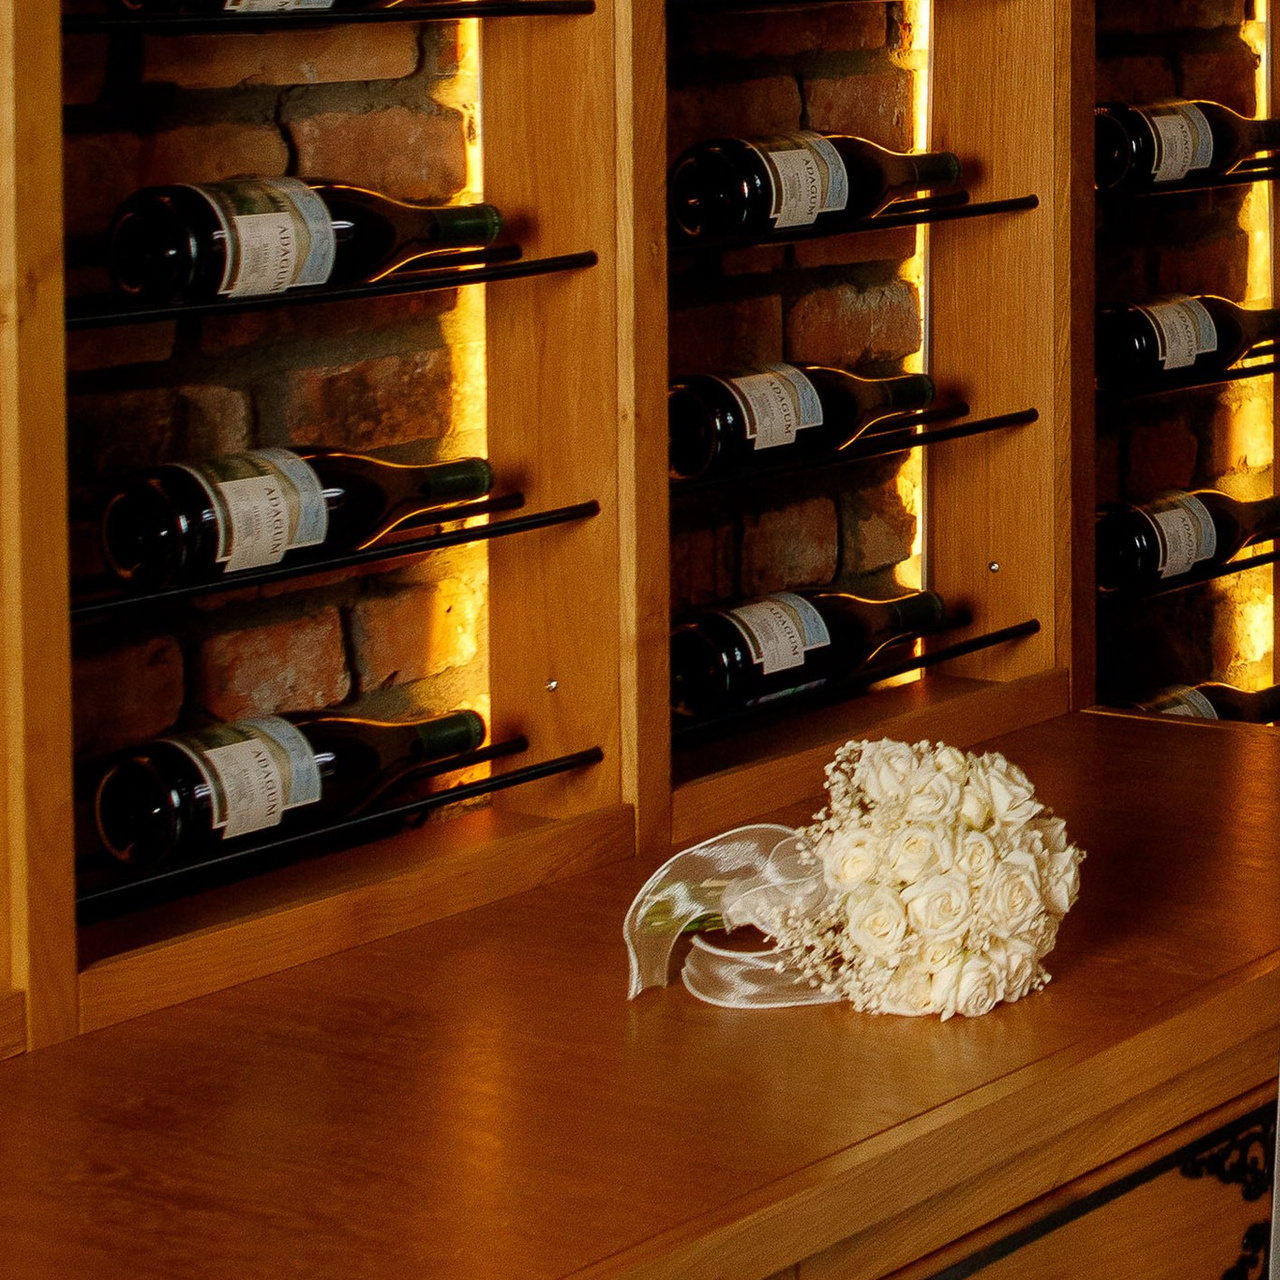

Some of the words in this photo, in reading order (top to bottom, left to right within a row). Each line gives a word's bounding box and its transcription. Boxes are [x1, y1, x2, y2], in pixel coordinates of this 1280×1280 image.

[803, 159, 817, 216] ADAGUM
[269, 224, 291, 292] ADAGUM
[769, 380, 792, 435] ADAGUM
[264, 487, 283, 554] ADAGUM
[767, 606, 799, 656] ADAGUM
[251, 750, 277, 818] ADAGUM
